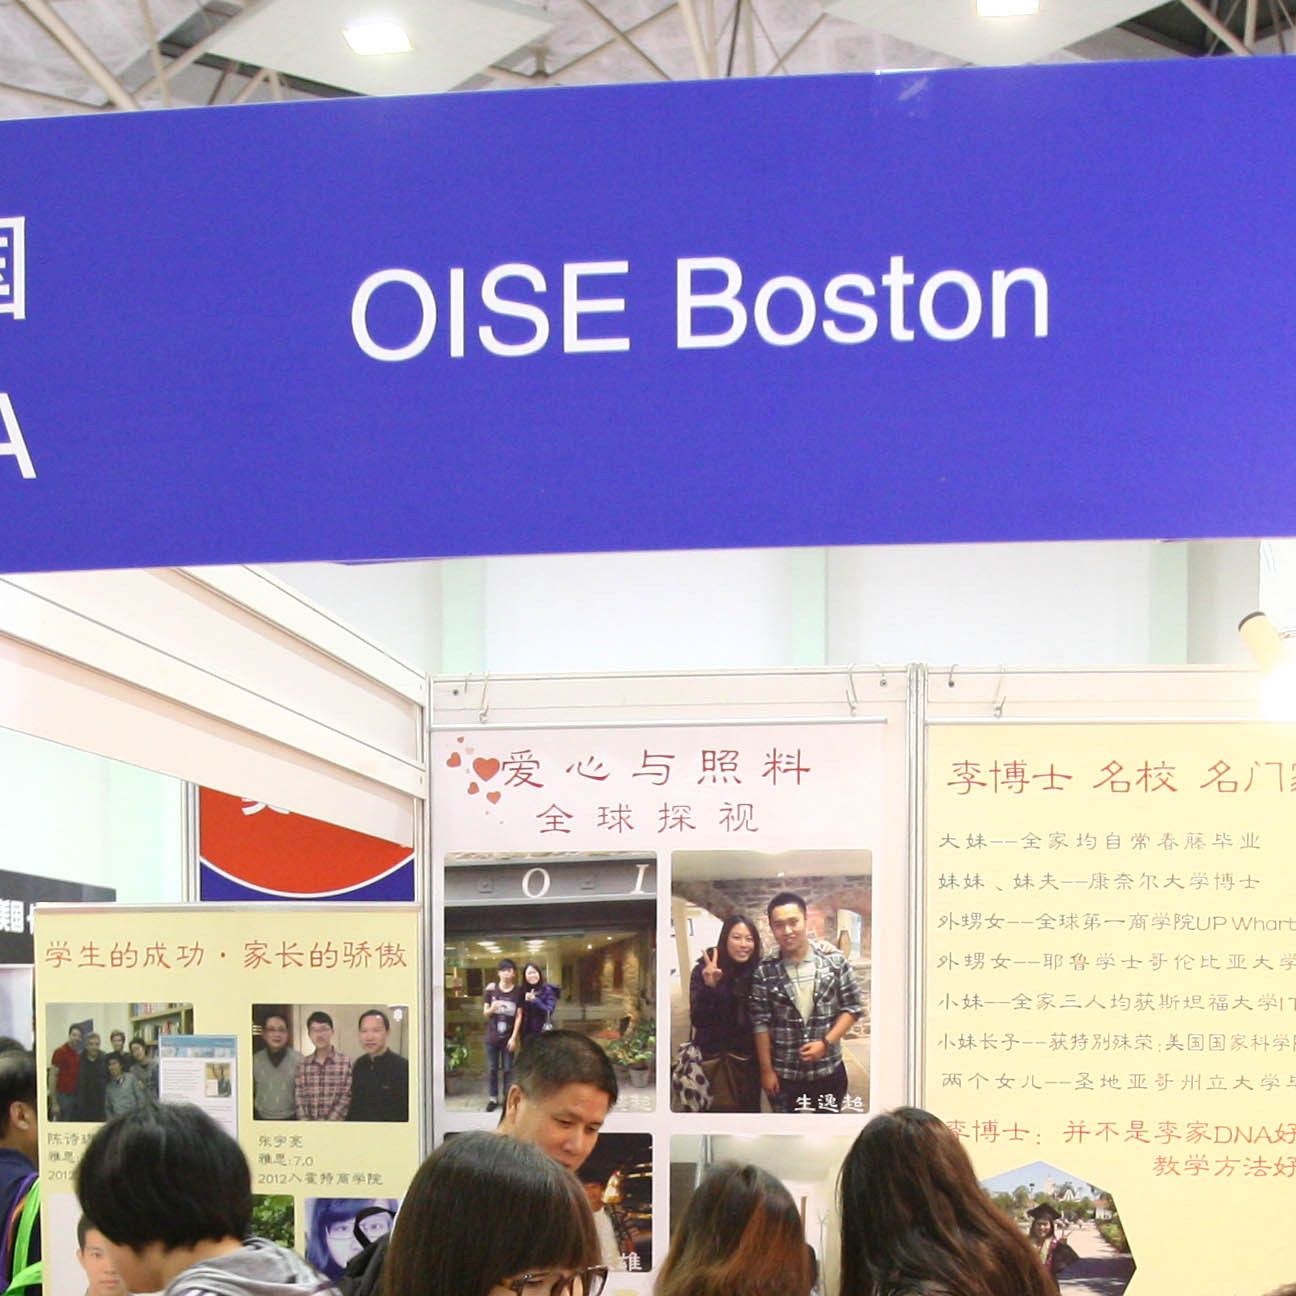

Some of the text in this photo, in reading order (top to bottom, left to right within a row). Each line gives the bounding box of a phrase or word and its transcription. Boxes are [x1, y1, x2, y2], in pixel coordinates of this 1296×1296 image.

[350, 254, 1050, 362] OISE Boston
[501, 746, 811, 789] 爱心与照料
[946, 758, 1073, 796] 李博士
[1091, 758, 1178, 795] 名校
[535, 802, 760, 835] 全球探视
